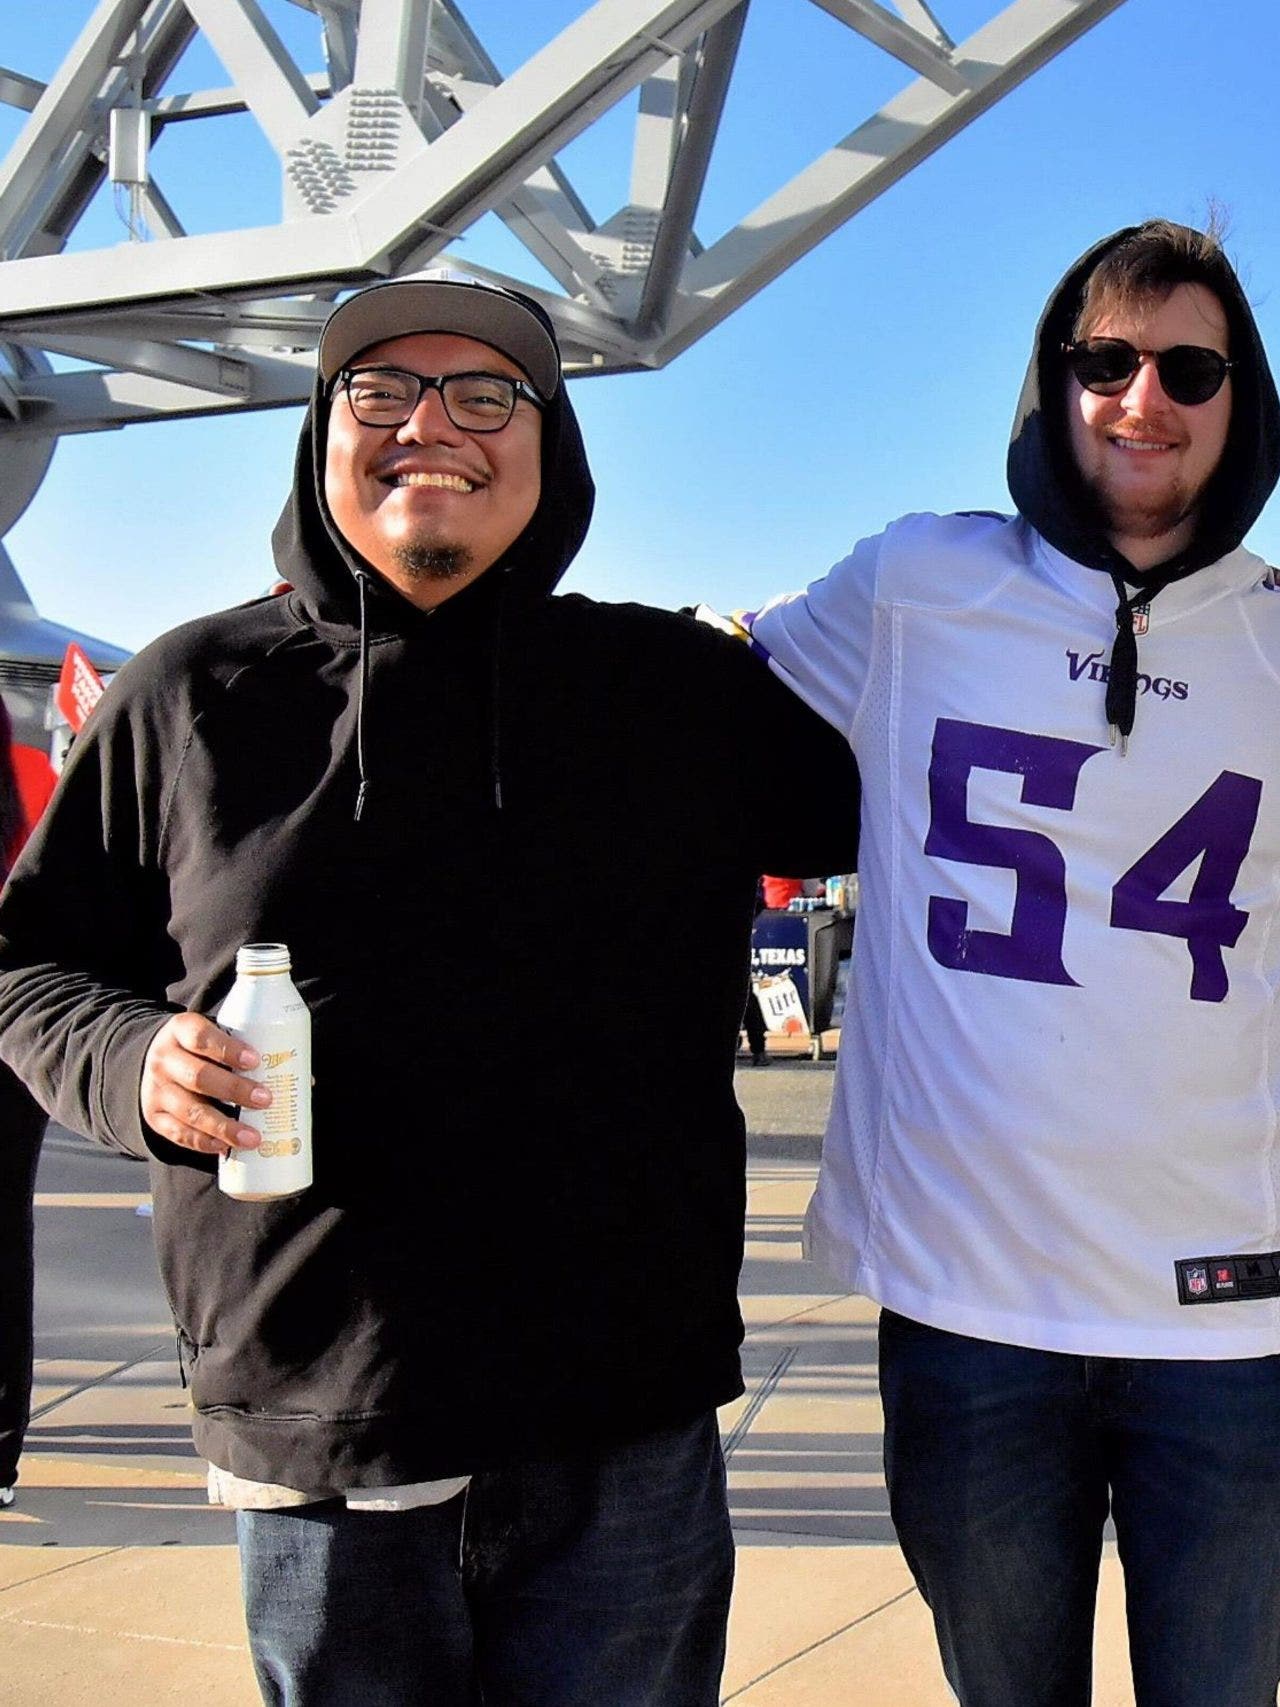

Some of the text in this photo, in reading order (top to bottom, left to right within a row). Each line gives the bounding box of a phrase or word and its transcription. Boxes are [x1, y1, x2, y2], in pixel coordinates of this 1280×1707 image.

[1065, 648, 1189, 701] VINGS
[923, 716, 1264, 1004] 54
[759, 948, 806, 966] TEXAS
